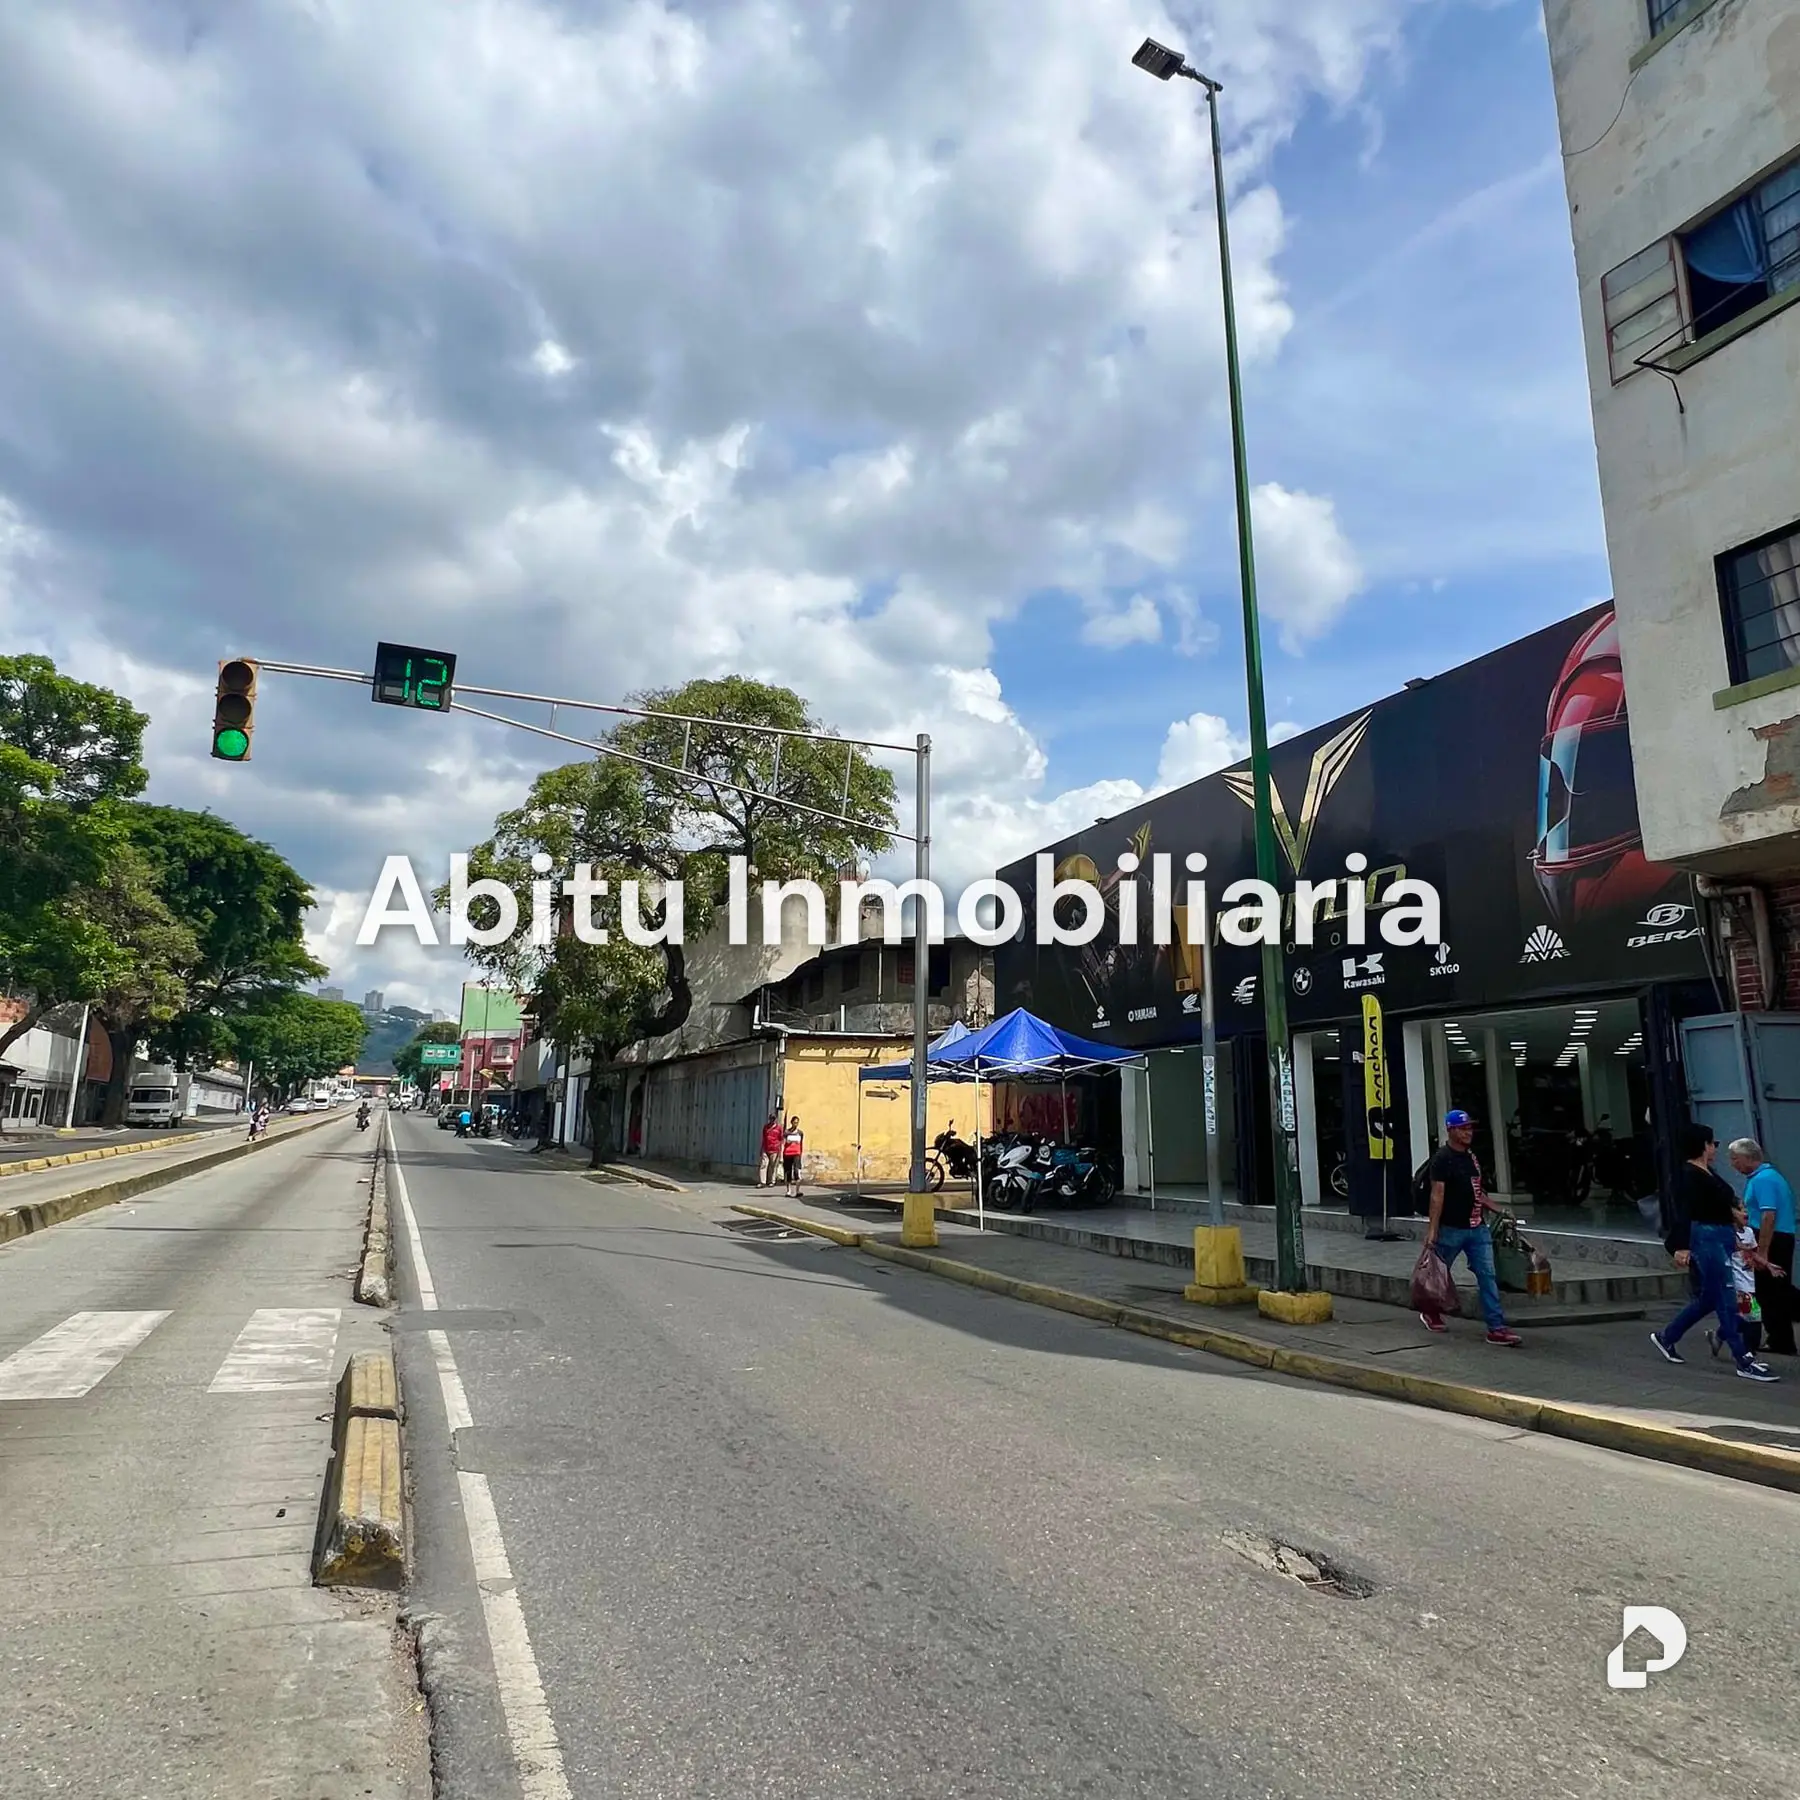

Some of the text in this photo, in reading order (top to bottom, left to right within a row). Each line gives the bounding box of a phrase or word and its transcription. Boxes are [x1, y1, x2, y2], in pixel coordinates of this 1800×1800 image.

[403, 658, 447, 706] 12
[1626, 927, 1705, 948] BERA
[1526, 950, 1563, 963] AVA
[1429, 963, 1460, 977] SKYGO
[1343, 974, 1386, 989] Kawasaki
[1134, 1006, 1158, 1021] YAMAHA
